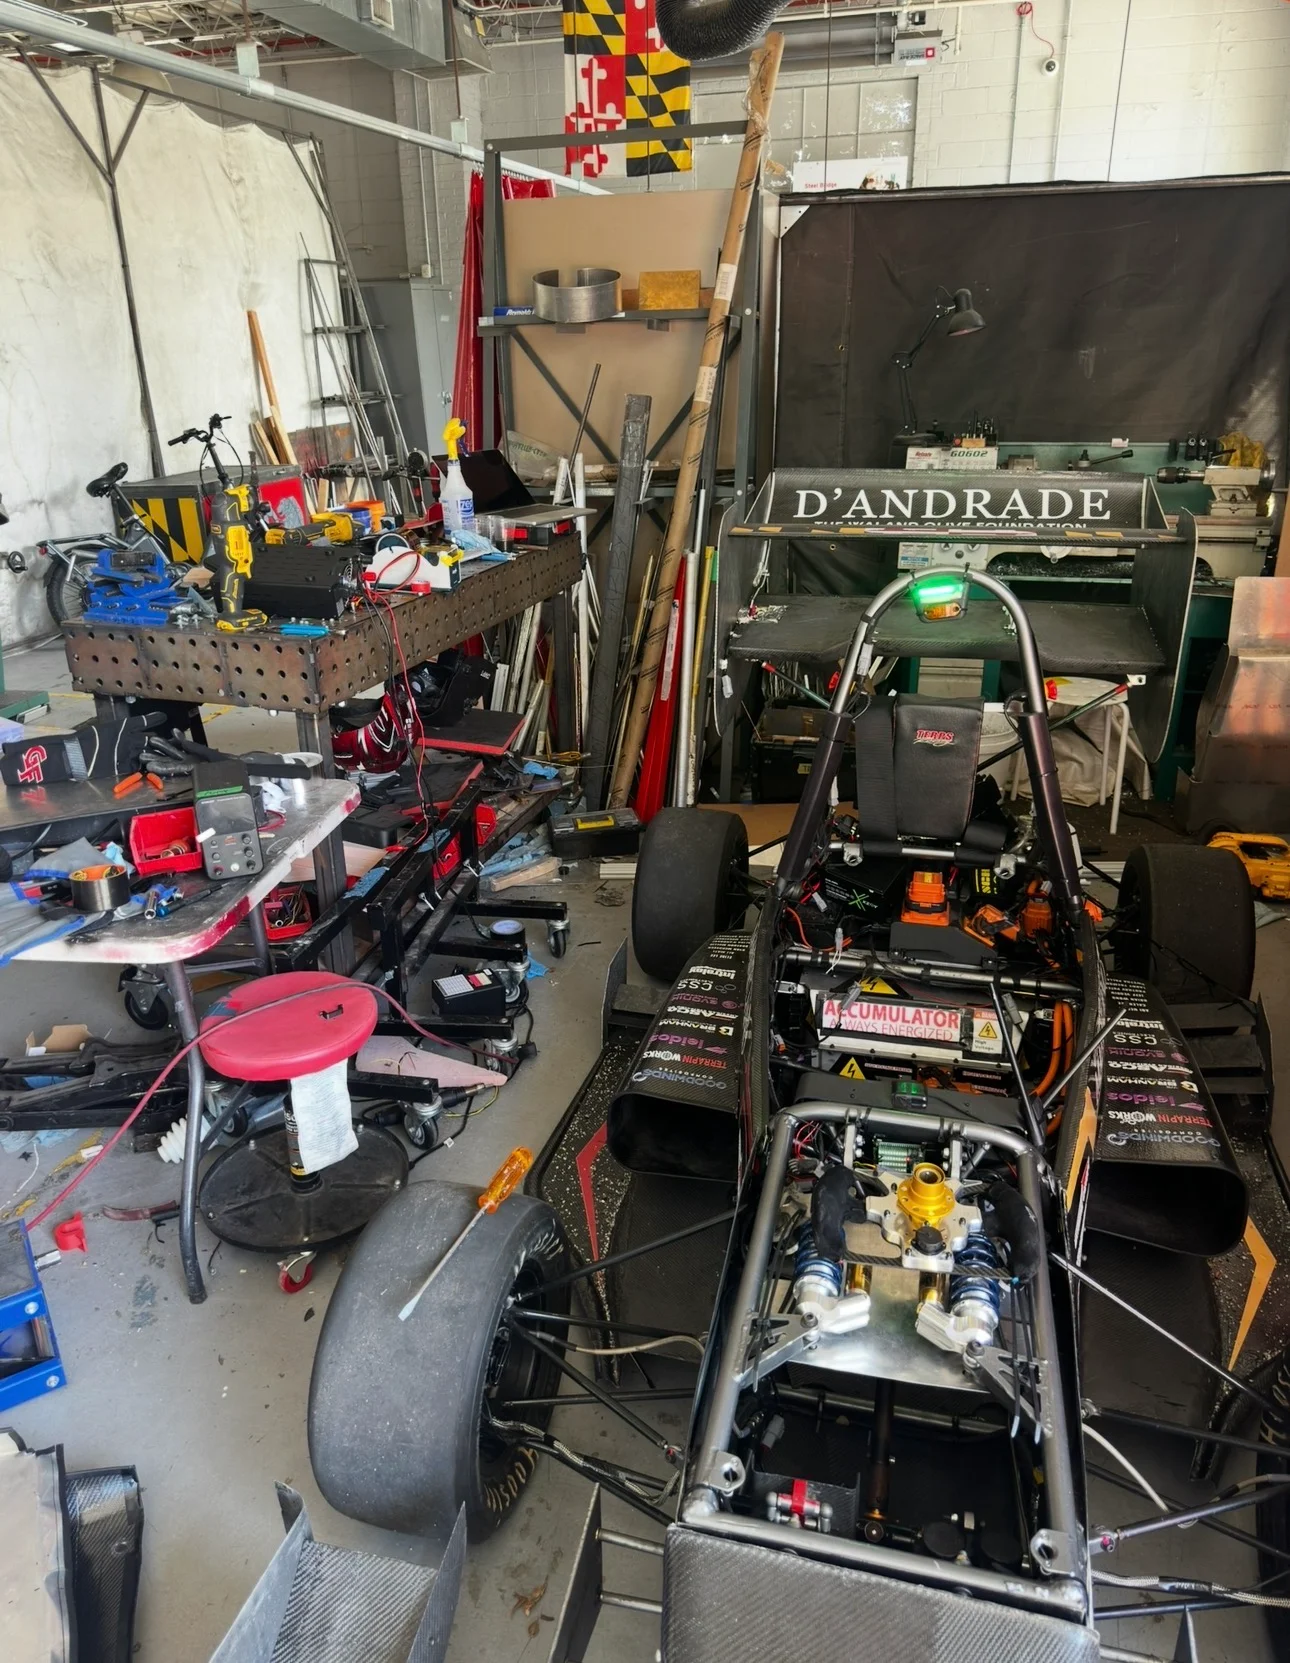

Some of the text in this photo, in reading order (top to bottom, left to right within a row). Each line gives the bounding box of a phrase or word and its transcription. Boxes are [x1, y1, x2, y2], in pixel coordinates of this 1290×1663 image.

[917, 730, 954, 742] TERPS
[677, 981, 713, 991] CSS
[825, 999, 959, 1029] ACCUMULATOR
[659, 1019, 716, 1031] BRANHAM
[830, 1018, 953, 1041] AWAYS ENERGIZED
[1117, 1020, 1165, 1030] Intralo
[1113, 1034, 1157, 1045] CSS
[642, 1050, 728, 1069] TERRAPIN WORKS
[1106, 1077, 1177, 1087] BRANHAM
[1107, 1092, 1176, 1106] leidos
[1108, 1110, 1213, 1127] TERRAPIN WORKS
